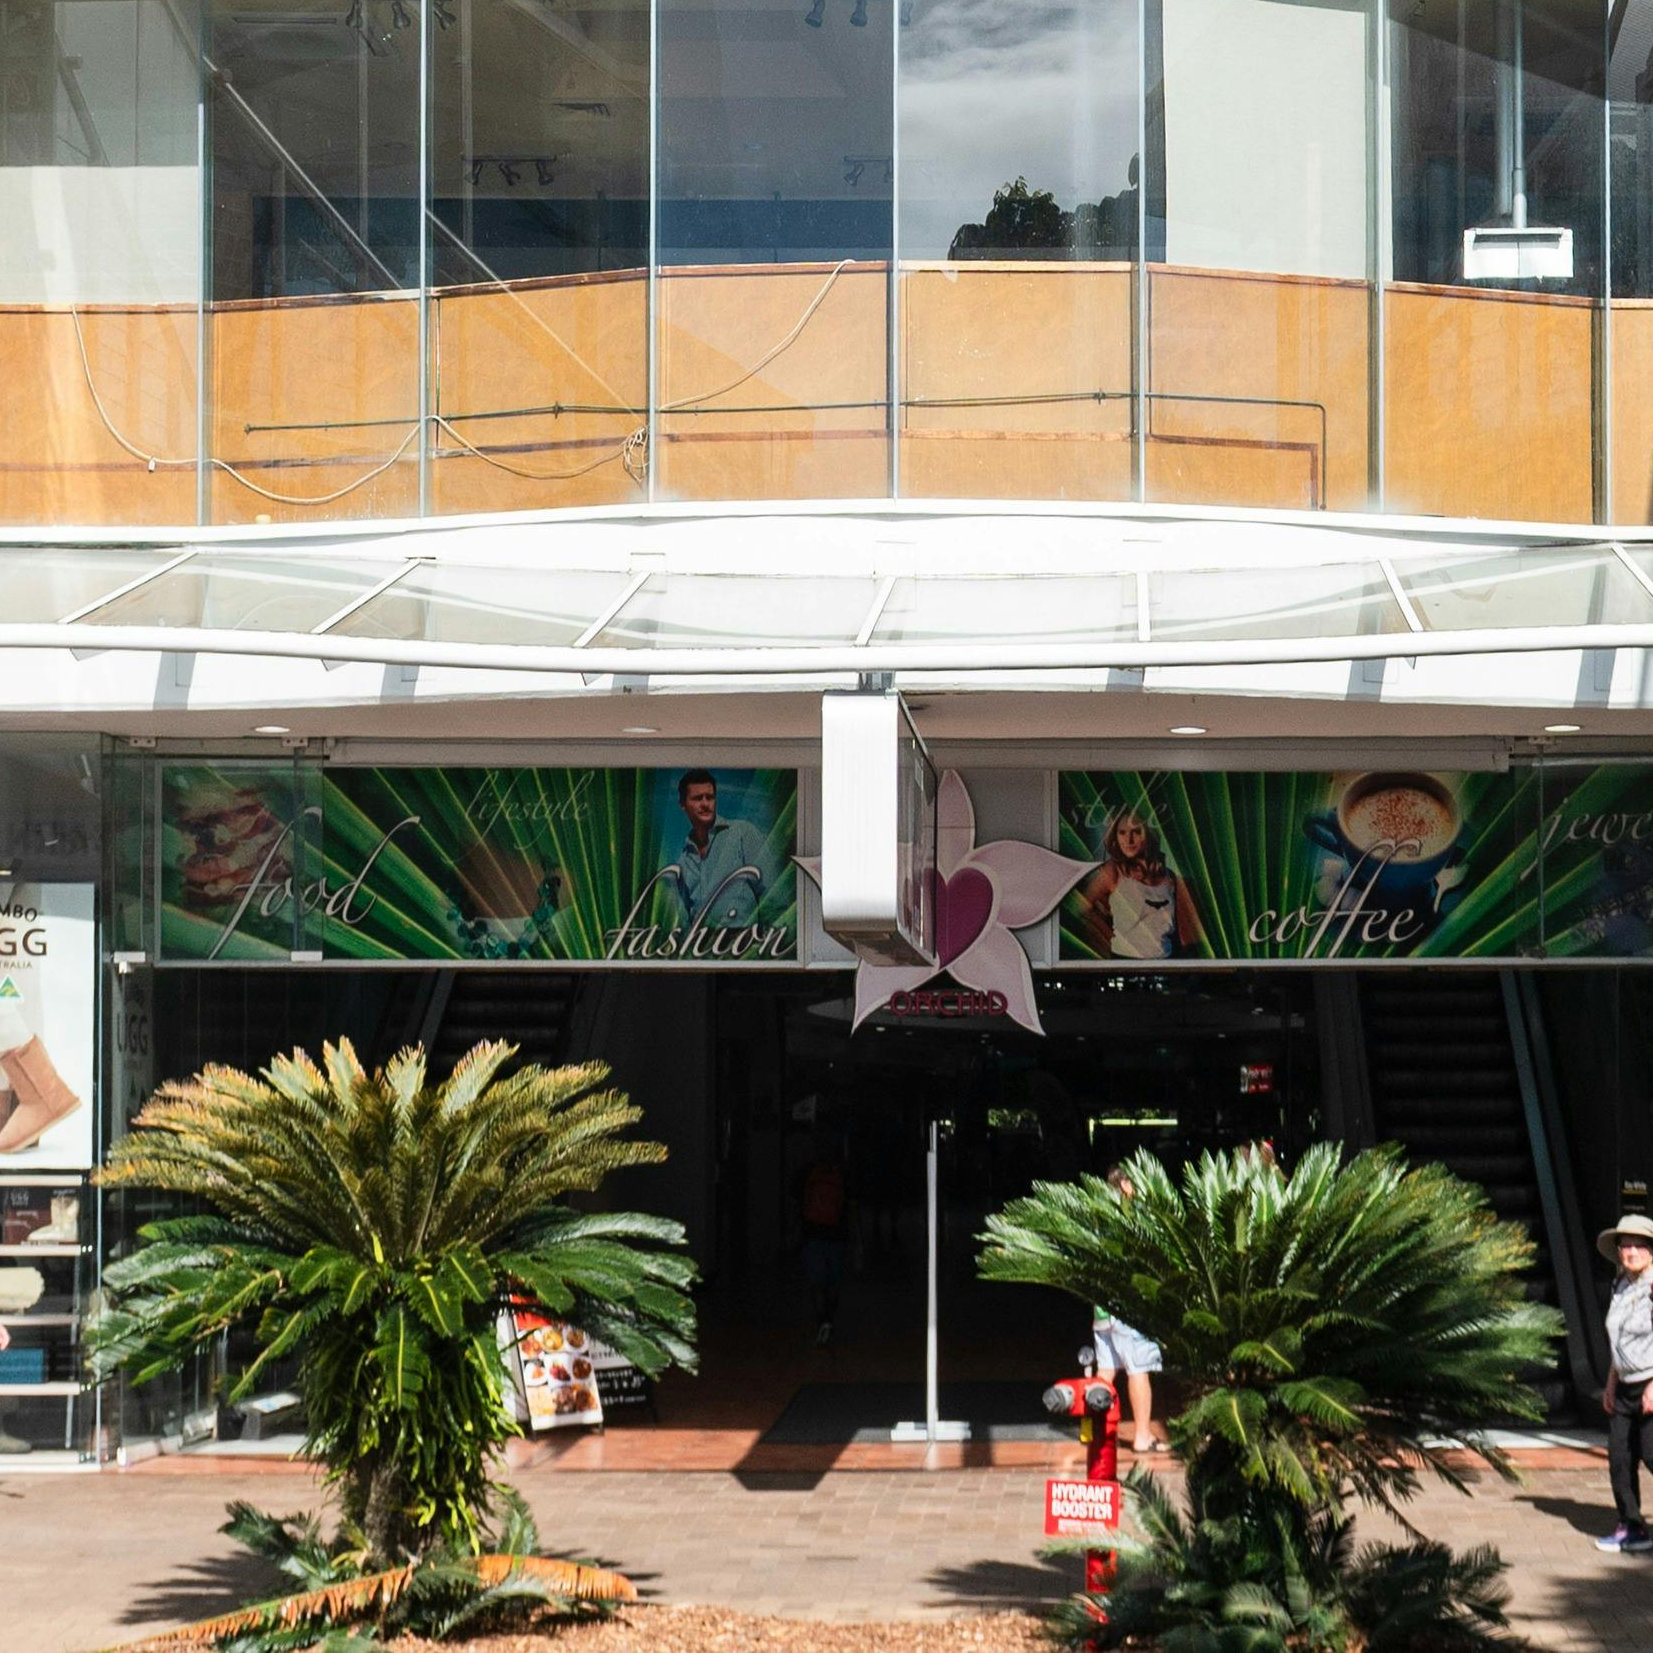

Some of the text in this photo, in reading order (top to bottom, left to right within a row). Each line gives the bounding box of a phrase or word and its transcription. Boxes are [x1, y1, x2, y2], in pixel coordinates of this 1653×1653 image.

[452, 770, 596, 858] lifestyle
[1066, 771, 1175, 854] style
[207, 805, 420, 960] food
[603, 865, 797, 960] fashion
[1248, 838, 1424, 958] coffee
[889, 989, 1009, 1017] ORCHID
[1051, 1482, 1114, 1503] HYDRANT
[1051, 1499, 1113, 1520] BOOSTER
